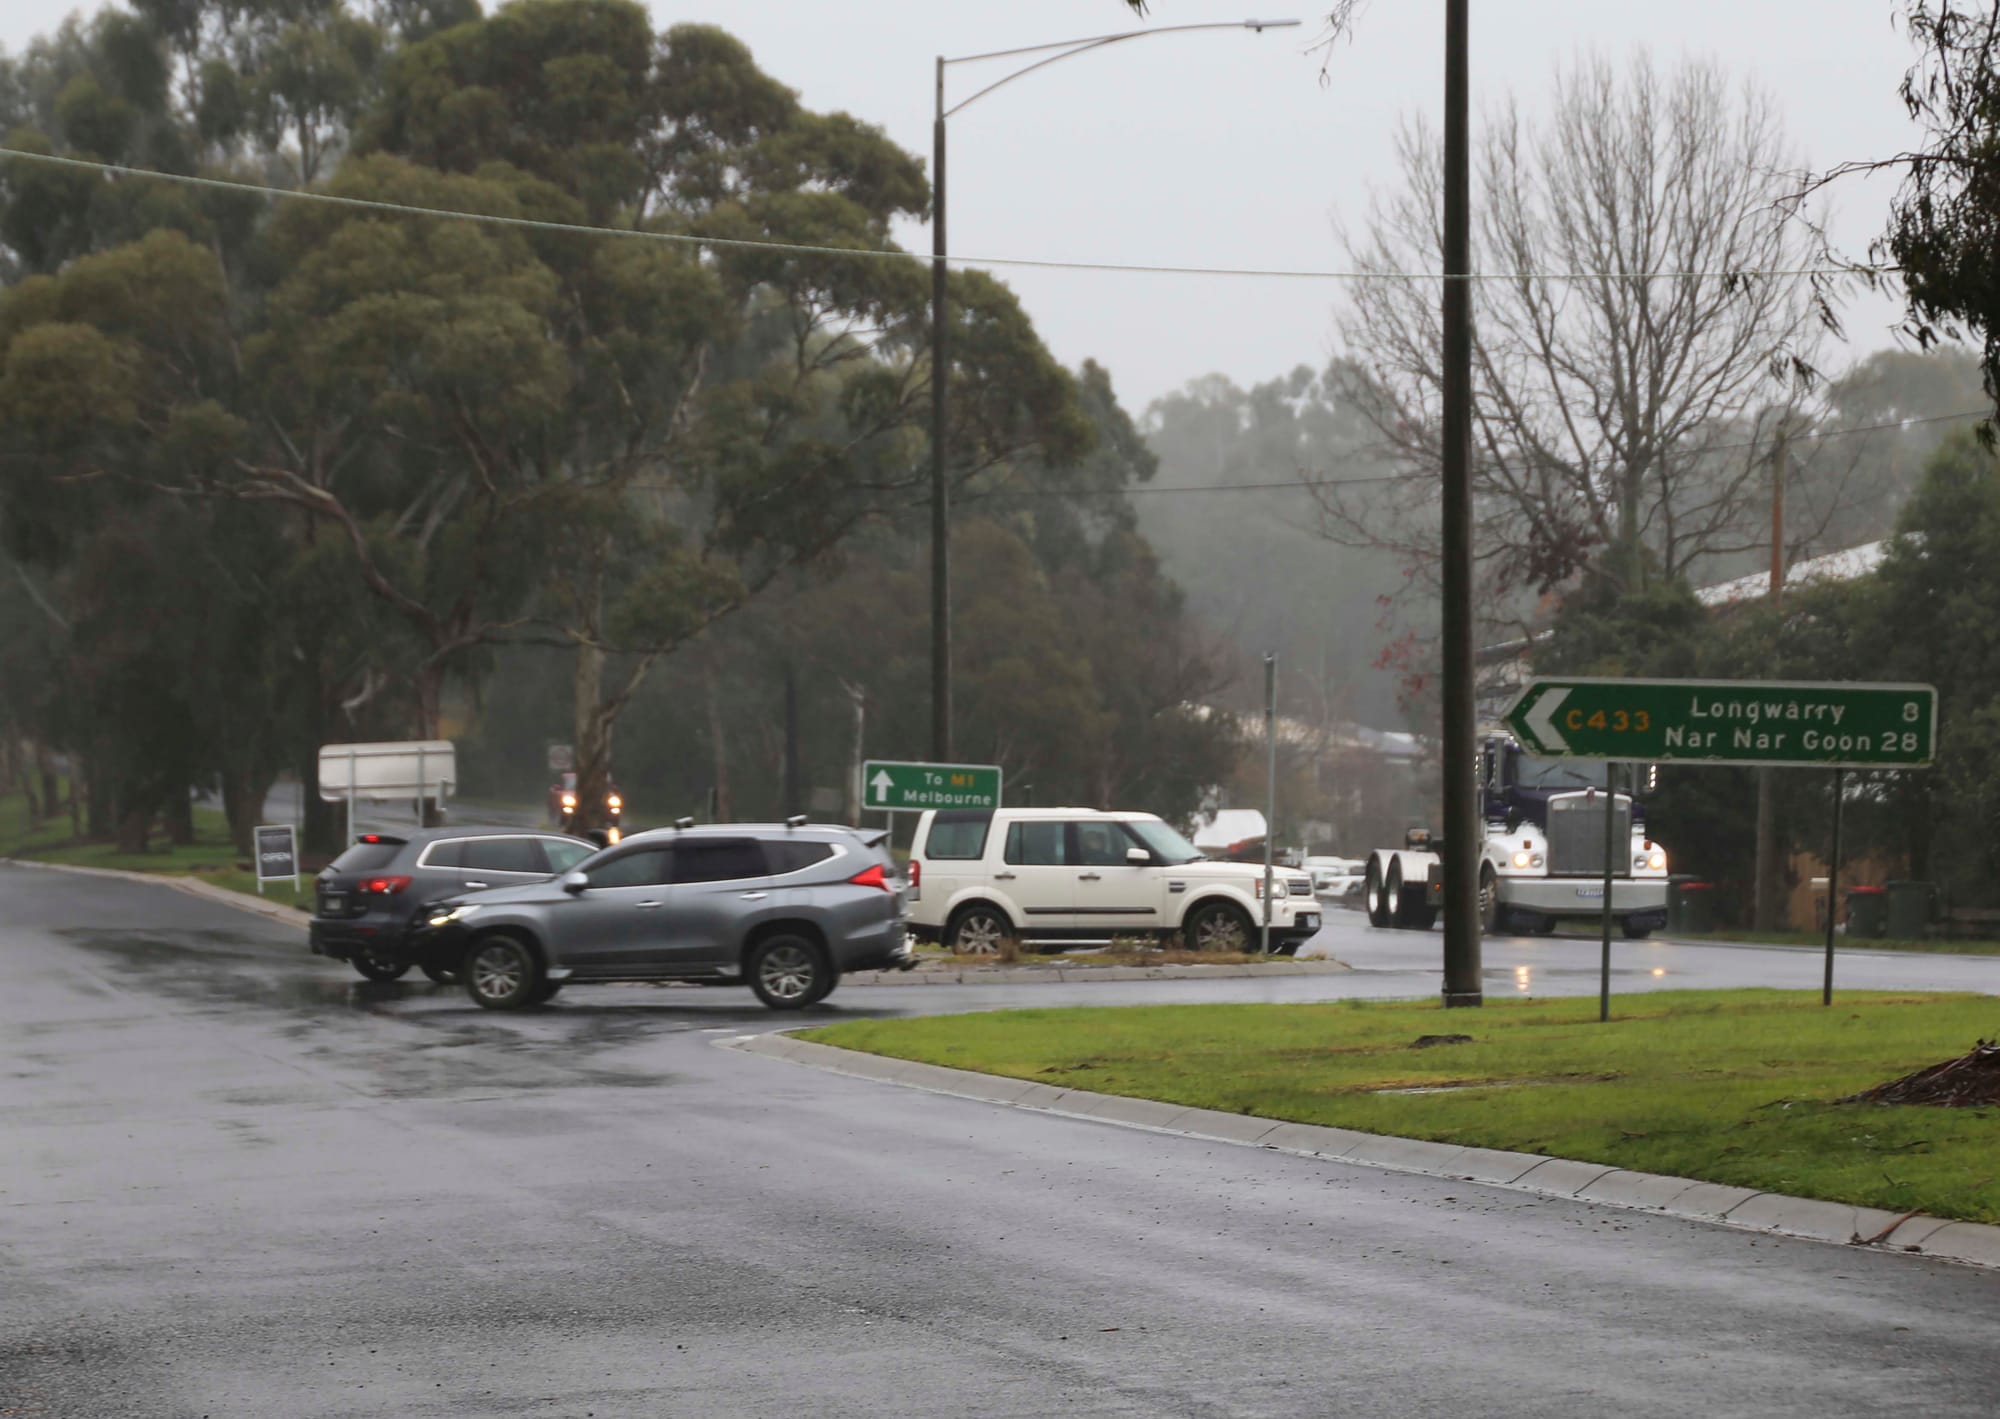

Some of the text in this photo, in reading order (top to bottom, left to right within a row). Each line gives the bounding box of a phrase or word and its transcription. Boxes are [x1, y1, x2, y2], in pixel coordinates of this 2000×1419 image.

[1565, 710, 1651, 731] C433
[1691, 696, 1920, 724] Longwarry 8
[1665, 726, 1919, 752] Nar Nar Goon 28
[924, 772, 943, 785] To
[903, 789, 992, 805] Melbourne
